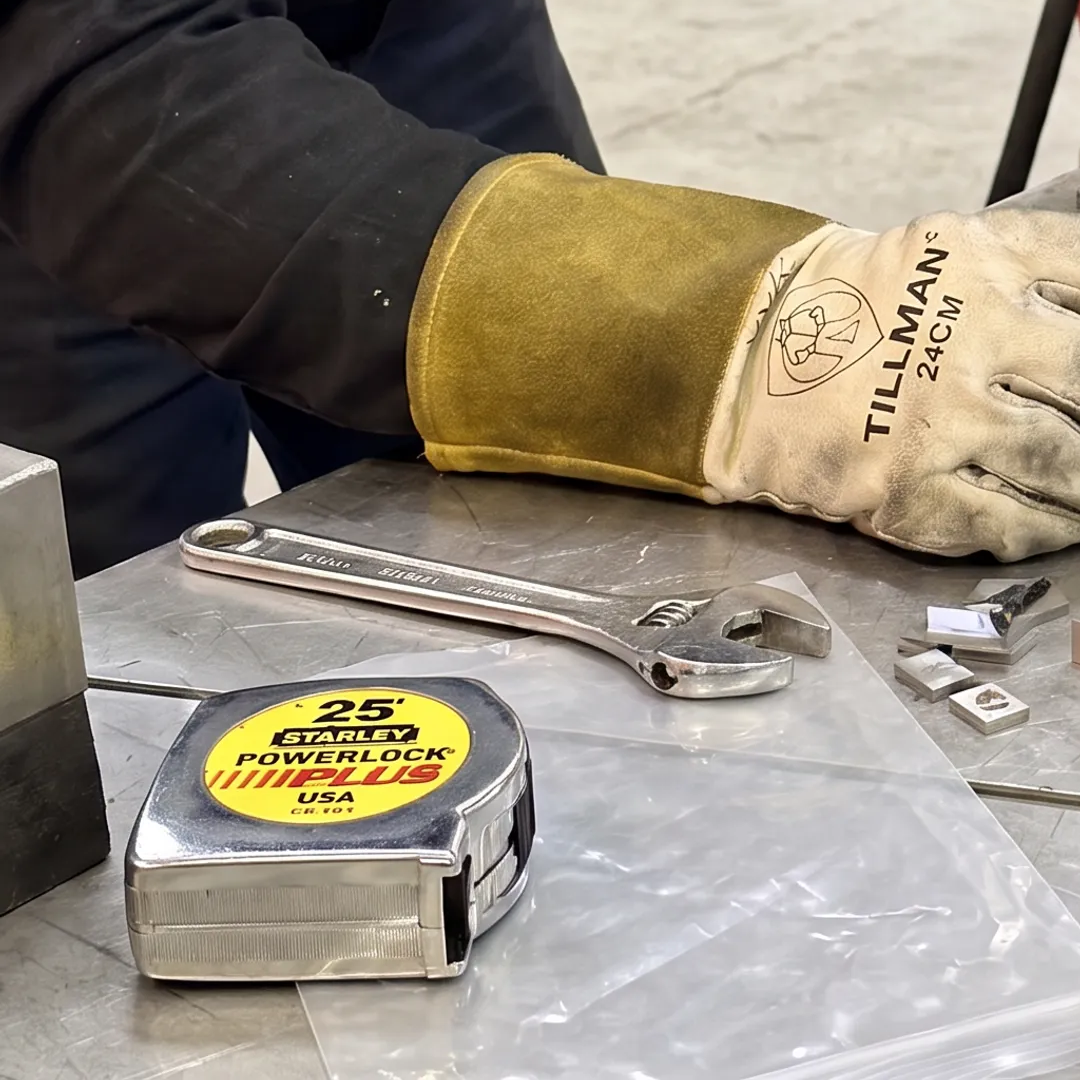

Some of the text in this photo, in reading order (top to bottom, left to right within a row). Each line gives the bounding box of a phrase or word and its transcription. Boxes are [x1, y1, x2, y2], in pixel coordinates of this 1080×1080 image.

[863, 247, 950, 443] TILLMAN
[916, 295, 964, 382] 24CM
[236, 747, 449, 767] POWERLOCK
[286, 763, 443, 788] PLUS
[297, 791, 355, 804] USA
